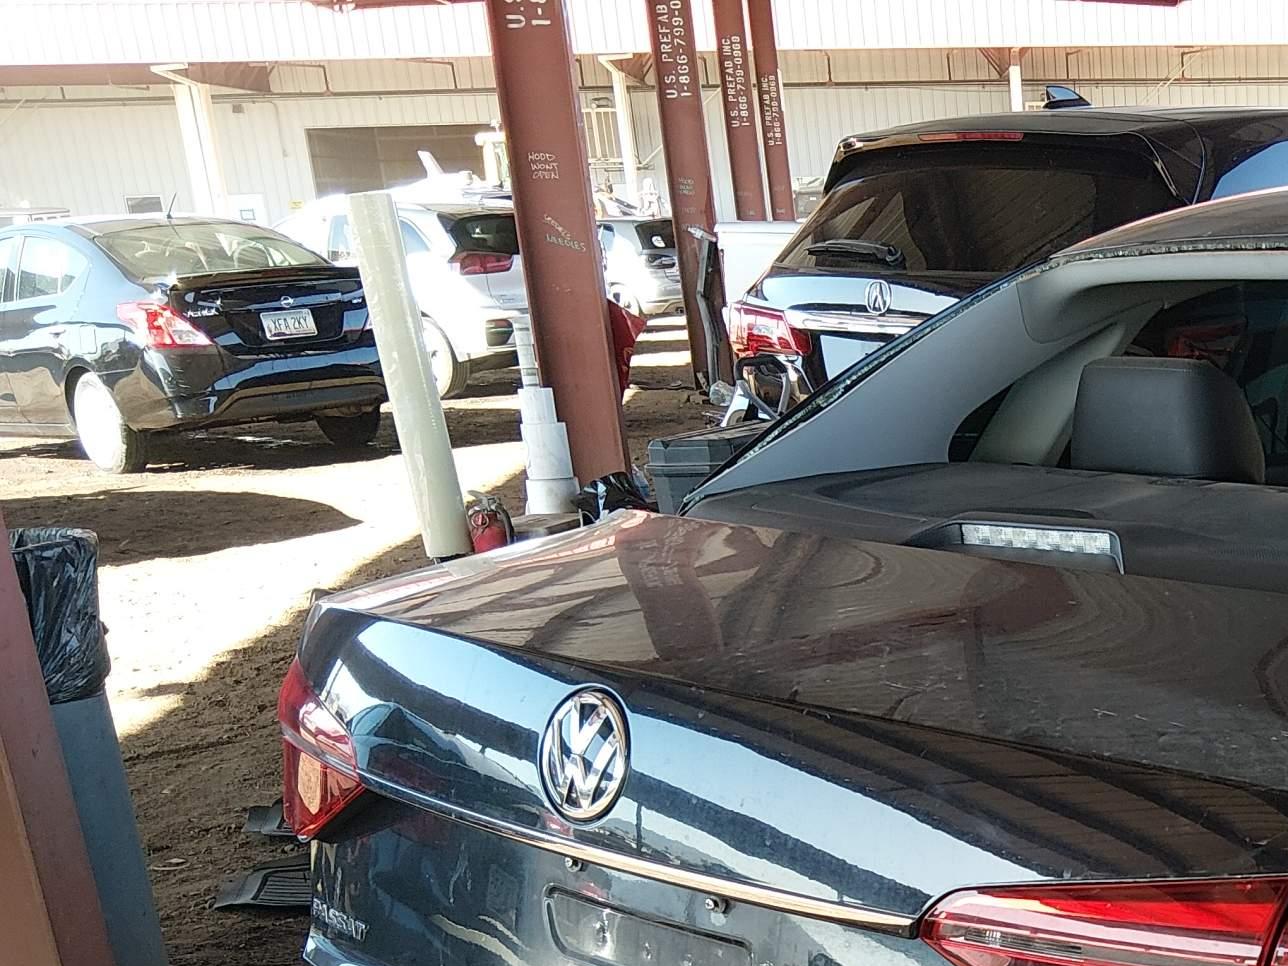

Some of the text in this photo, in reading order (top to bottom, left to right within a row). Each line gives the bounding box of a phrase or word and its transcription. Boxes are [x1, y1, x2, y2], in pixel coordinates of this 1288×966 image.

[656, 4, 678, 98] U.S. PREFAB
[722, 35, 740, 127] U.S. PREFAB INC.
[763, 94, 773, 126] PREFAB
[532, 171, 559, 180] OPEN
[312, 897, 370, 942] PASSAT
